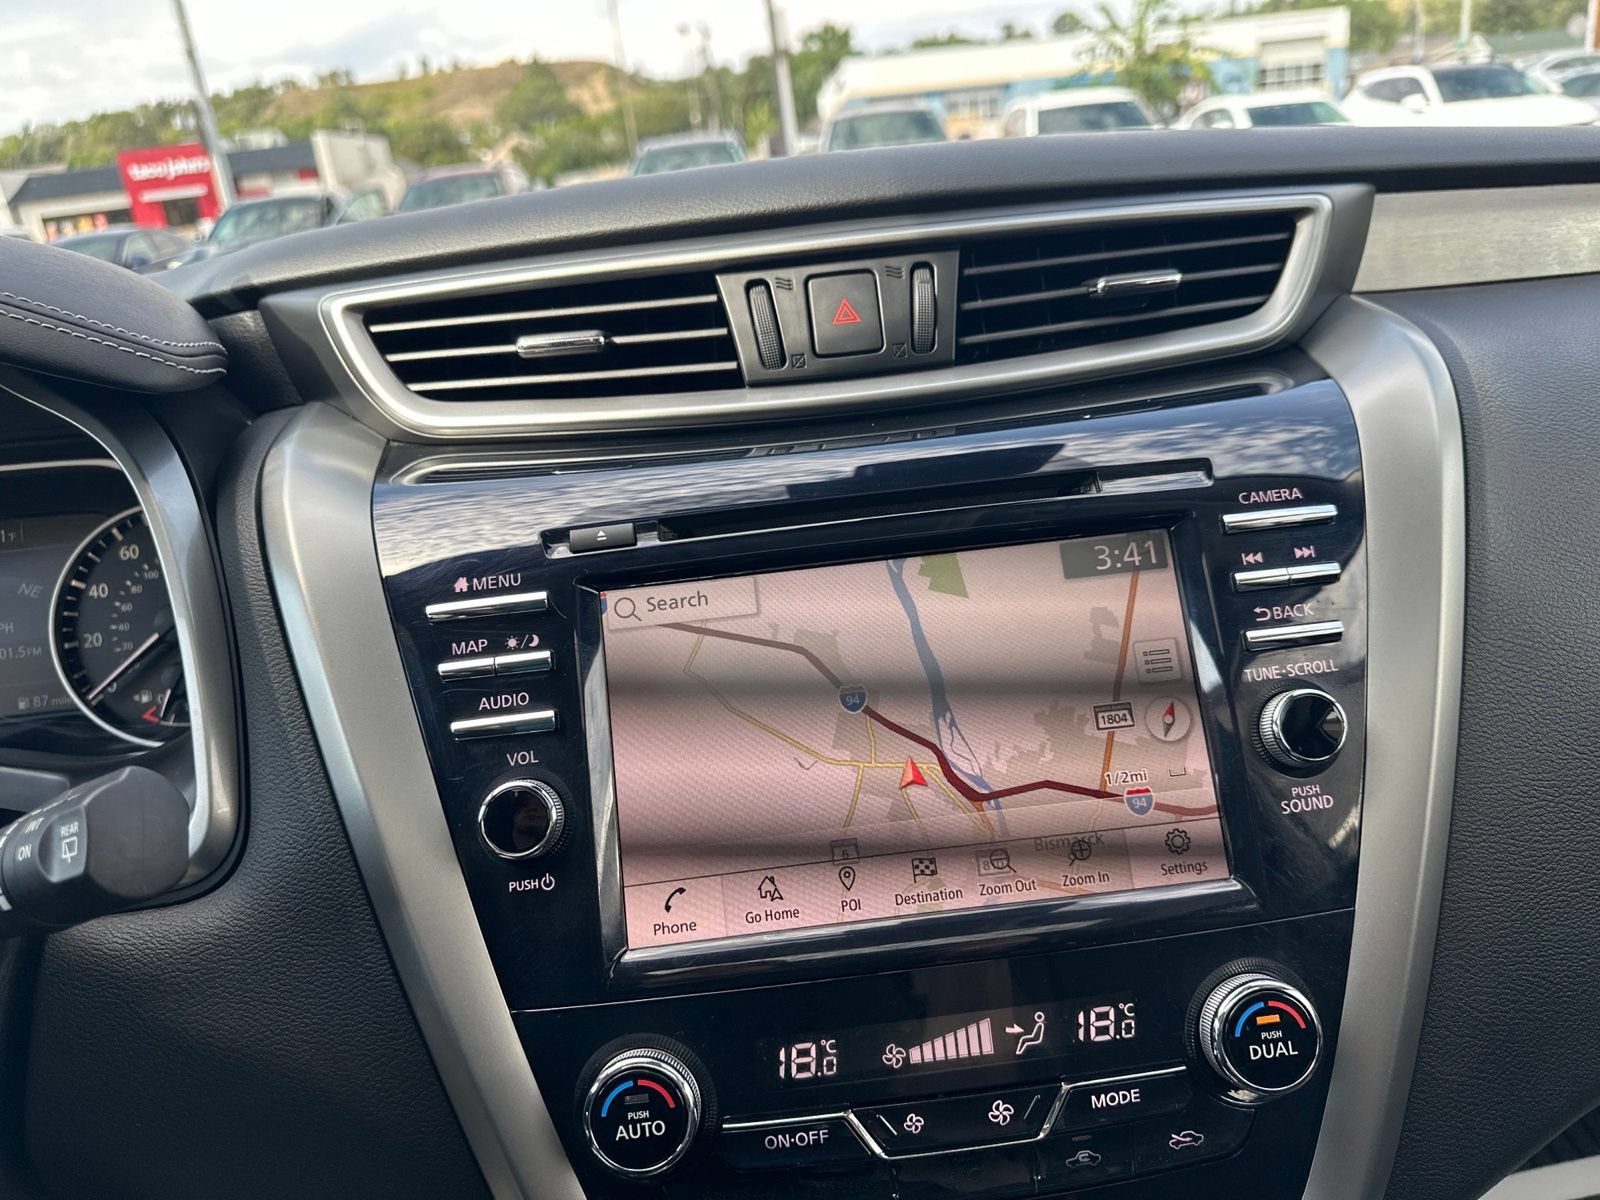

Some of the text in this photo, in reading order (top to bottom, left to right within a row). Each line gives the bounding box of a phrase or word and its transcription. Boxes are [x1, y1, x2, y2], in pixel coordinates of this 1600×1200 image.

[1238, 487, 1303, 505] CAMERA
[119, 544, 140, 561] 60
[1094, 540, 1158, 571] 3:41
[131, 584, 143, 595] 80
[472, 572, 522, 591] MENU
[17, 583, 44, 599] NE
[88, 583, 109, 600] 40
[121, 602, 133, 613] 60
[646, 590, 709, 613] Search
[1272, 602, 1315, 620] BACK
[118, 622, 130, 632] 40
[83, 632, 103, 649] 20
[451, 638, 489, 656] MAP
[32, 694, 49, 709] 87
[478, 691, 530, 711] AUDIO
[846, 694, 860, 706] 94
[1100, 712, 1129, 726] 1804
[506, 750, 540, 767] VOL
[1291, 784, 1321, 798] PUSH
[1131, 797, 1147, 809] 94
[1280, 795, 1335, 815] SOUND
[61, 821, 79, 837] REAR
[18, 844, 32, 861] ON
[1160, 861, 1208, 878] Settings
[508, 878, 540, 893] PUSH
[1062, 871, 1110, 887] Zoom In
[894, 886, 964, 907] Destination
[979, 879, 1037, 897] Zoom Out
[841, 898, 862, 913] POI
[745, 907, 800, 925] Go Home
[653, 919, 697, 936] Phone
[1260, 1030, 1283, 1040] PUSH
[1248, 1040, 1299, 1061] DUAL
[1090, 1088, 1141, 1110] MODE
[627, 1109, 650, 1121] PUSH
[615, 1120, 667, 1142] AUTO
